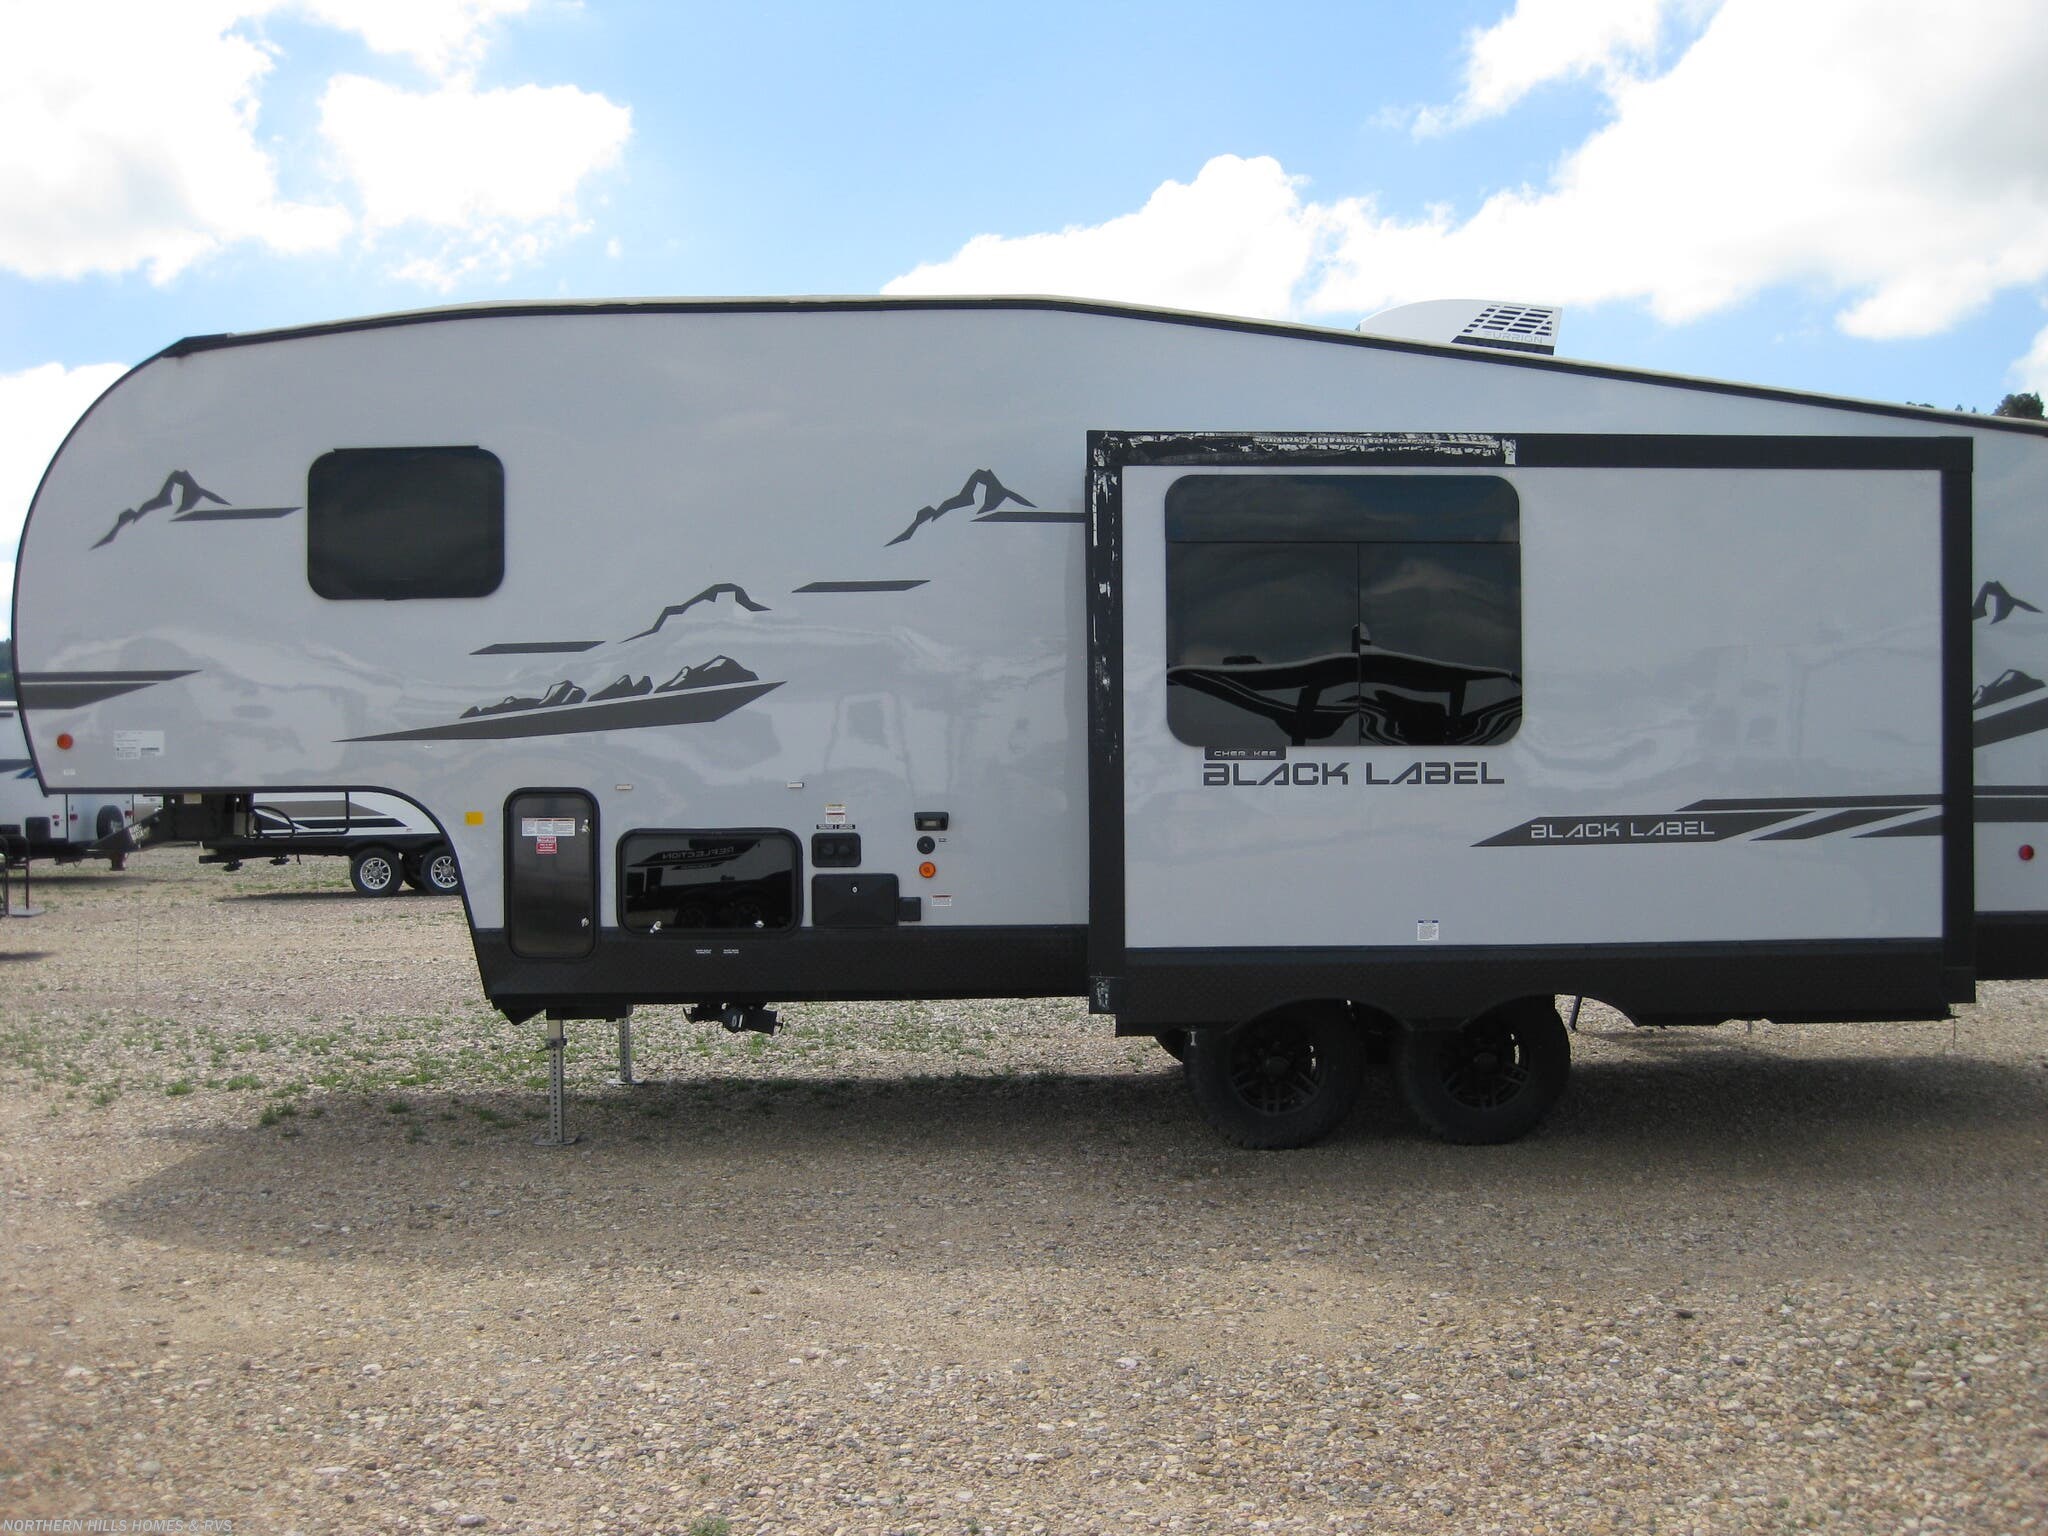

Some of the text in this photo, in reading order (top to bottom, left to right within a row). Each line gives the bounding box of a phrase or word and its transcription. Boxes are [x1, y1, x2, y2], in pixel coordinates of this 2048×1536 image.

[1213, 749, 1278, 758] CHERKEE
[1203, 761, 1505, 786] BLACK LABEL
[1530, 821, 1715, 839] BLACK LABEL
